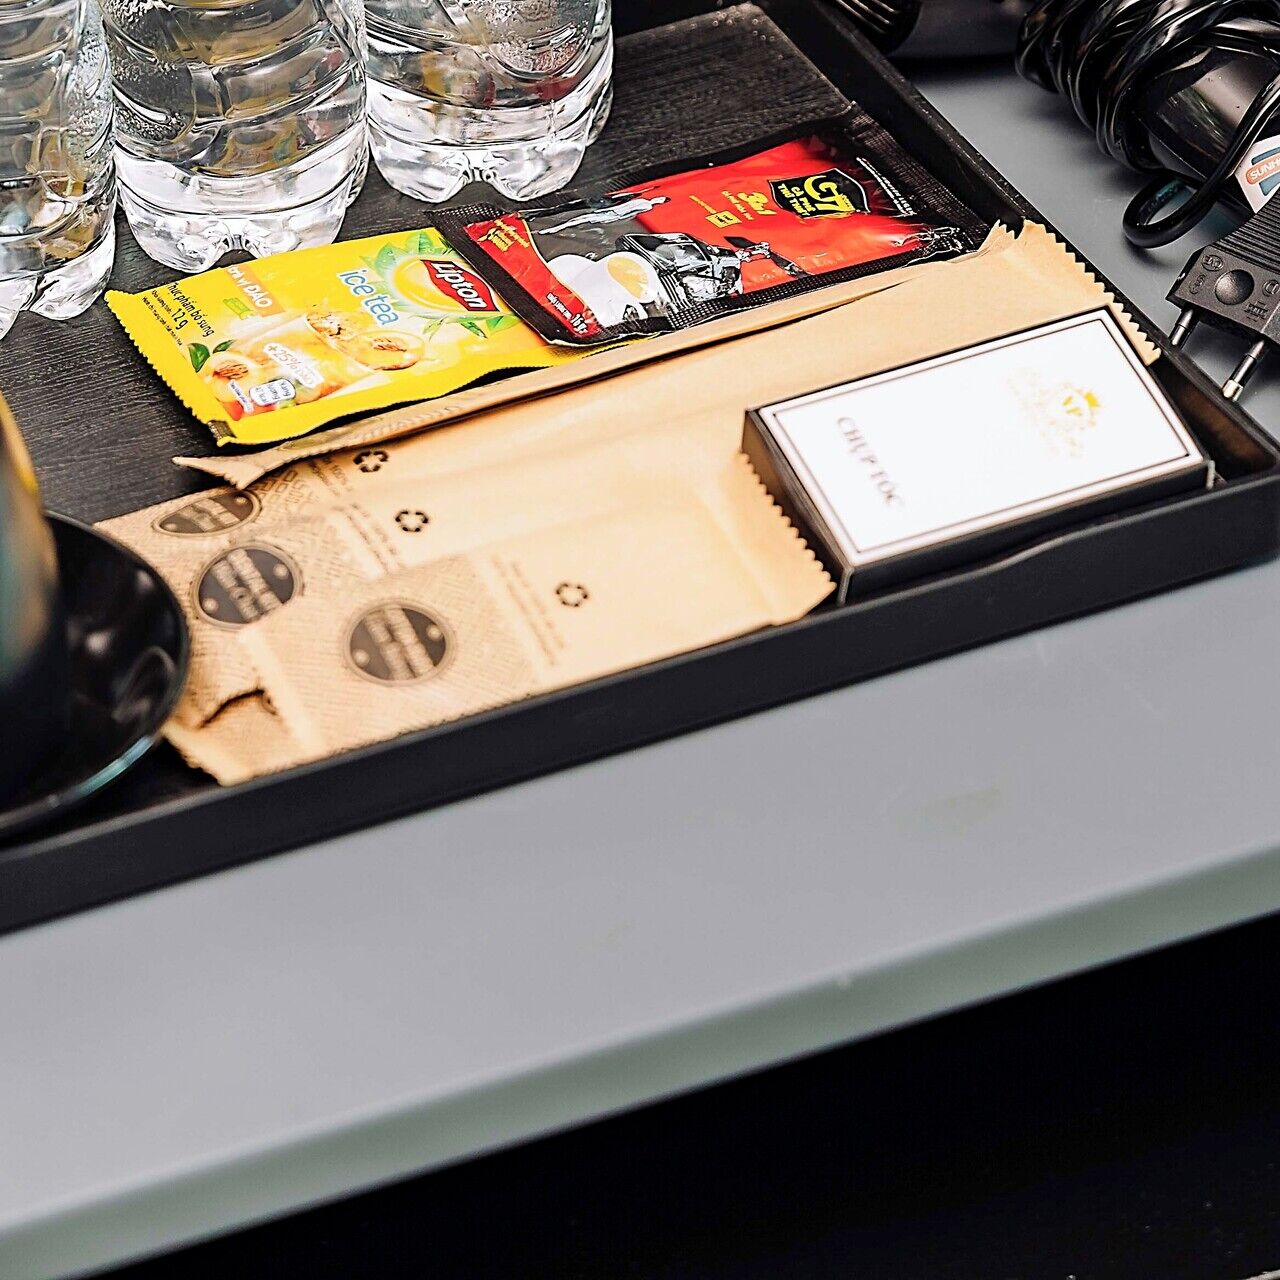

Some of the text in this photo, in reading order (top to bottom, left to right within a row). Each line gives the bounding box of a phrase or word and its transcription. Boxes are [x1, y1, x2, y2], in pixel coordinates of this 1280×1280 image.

[804, 175, 856, 213] G7
[339, 269, 400, 326] ice tea
[431, 262, 487, 309] Lipton
[171, 308, 186, 323] 12
[175, 319, 189, 331] g
[197, 319, 215, 338] sung
